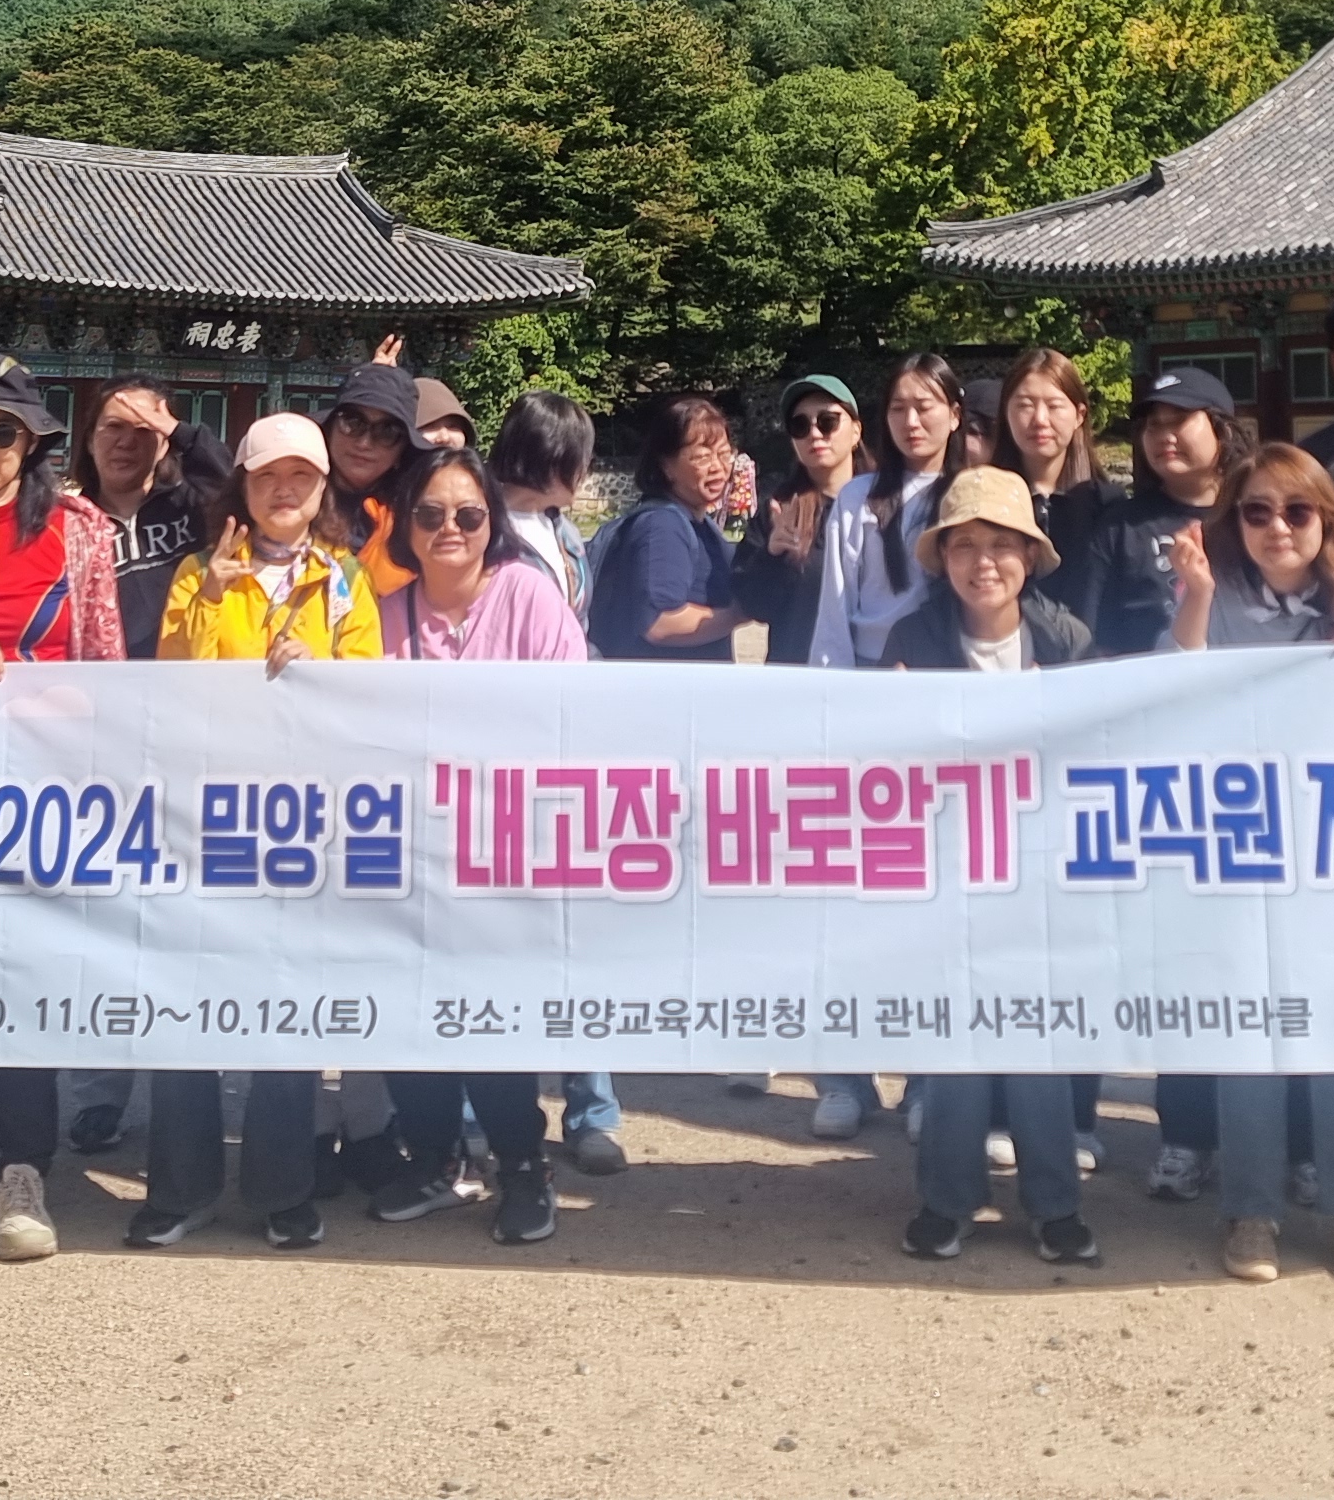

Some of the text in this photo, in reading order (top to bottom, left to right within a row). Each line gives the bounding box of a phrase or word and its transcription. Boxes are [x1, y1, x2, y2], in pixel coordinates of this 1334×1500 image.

[202, 783, 326, 888] 밀양
[345, 783, 403, 888] 얼
[436, 763, 681, 892] '내고장
[706, 758, 1031, 891] 바로알기'
[1066, 762, 1284, 884] 교직원
[432, 996, 521, 1039] 장소:
[542, 996, 807, 1039] 밀양교육지원청
[822, 996, 859, 1039] 외
[874, 996, 952, 1039] 관내
[968, 996, 1100, 1039] 사적지,
[1114, 994, 1312, 1039] 애버미라클
